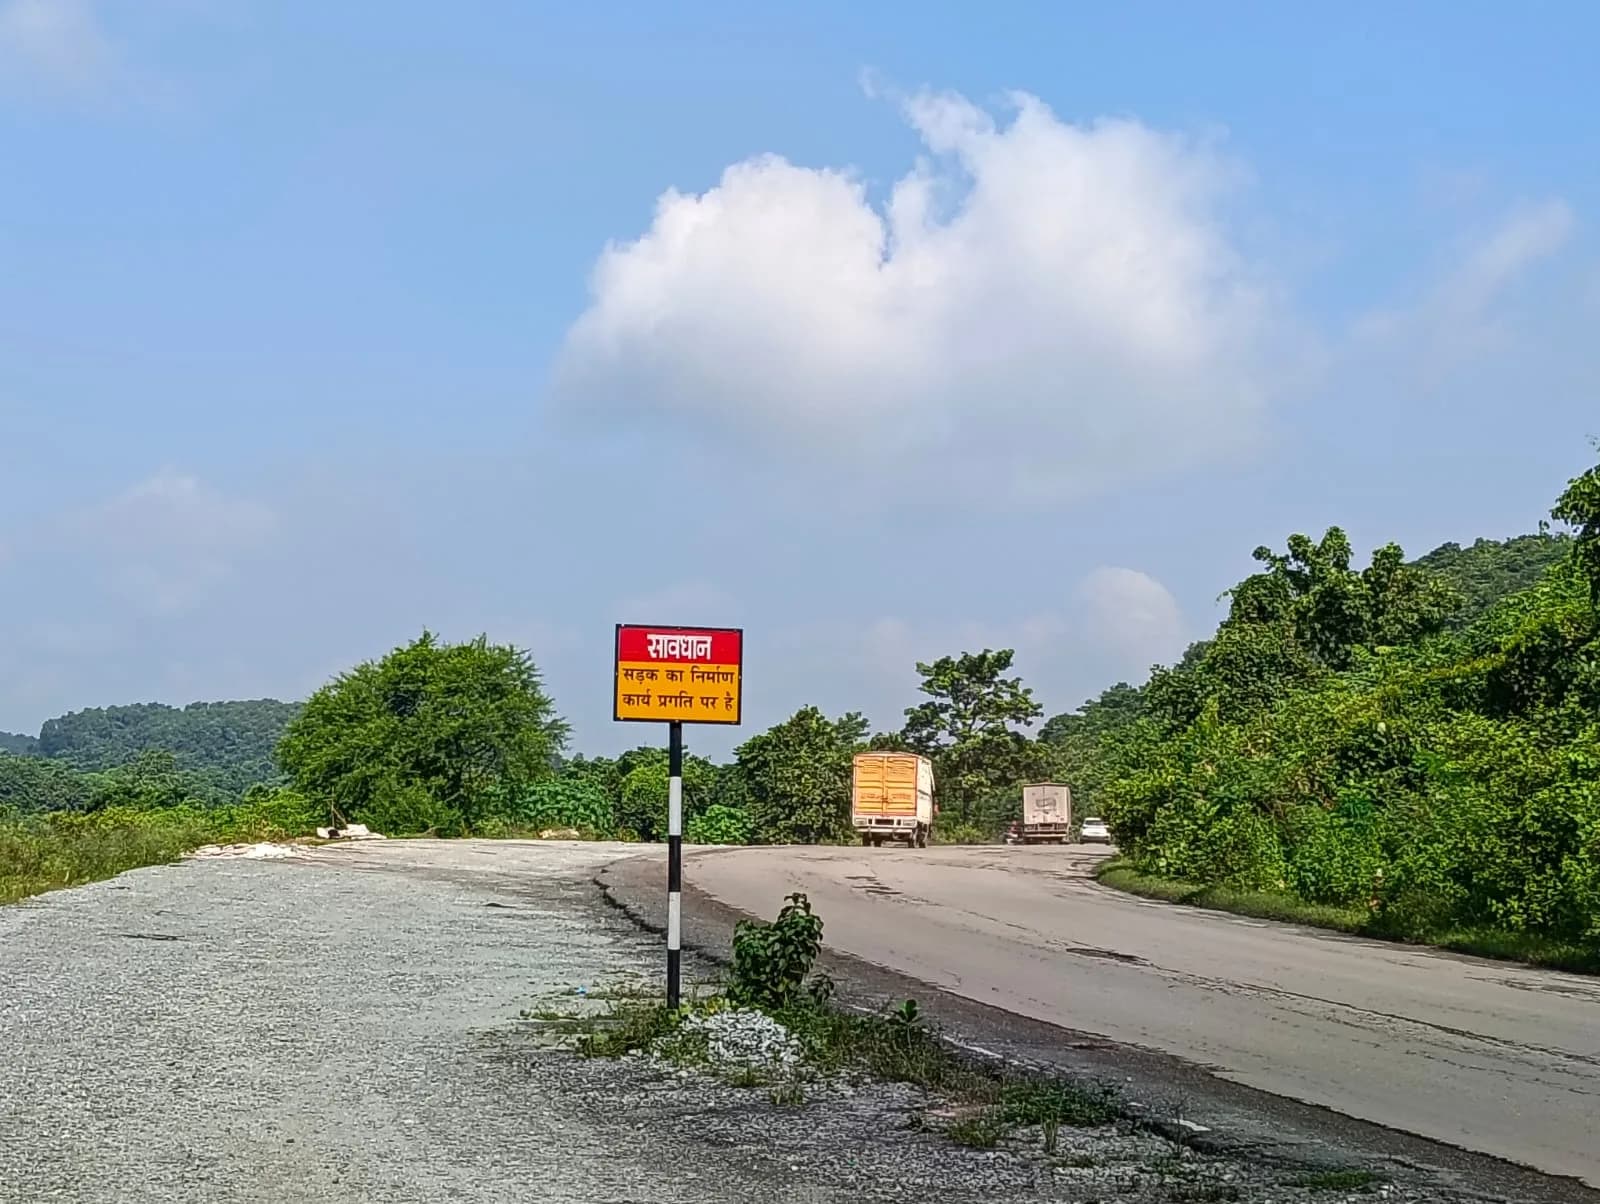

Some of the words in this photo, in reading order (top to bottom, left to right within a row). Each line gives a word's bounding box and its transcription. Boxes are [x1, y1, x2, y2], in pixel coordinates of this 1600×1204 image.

[647, 633, 712, 660] सावधान
[622, 668, 659, 685] सड़क
[665, 669, 684, 682] का
[690, 665, 735, 684] निर्माण
[622, 688, 651, 707] कार्य
[657, 690, 694, 708] प्रगति
[700, 696, 719, 709] पर
